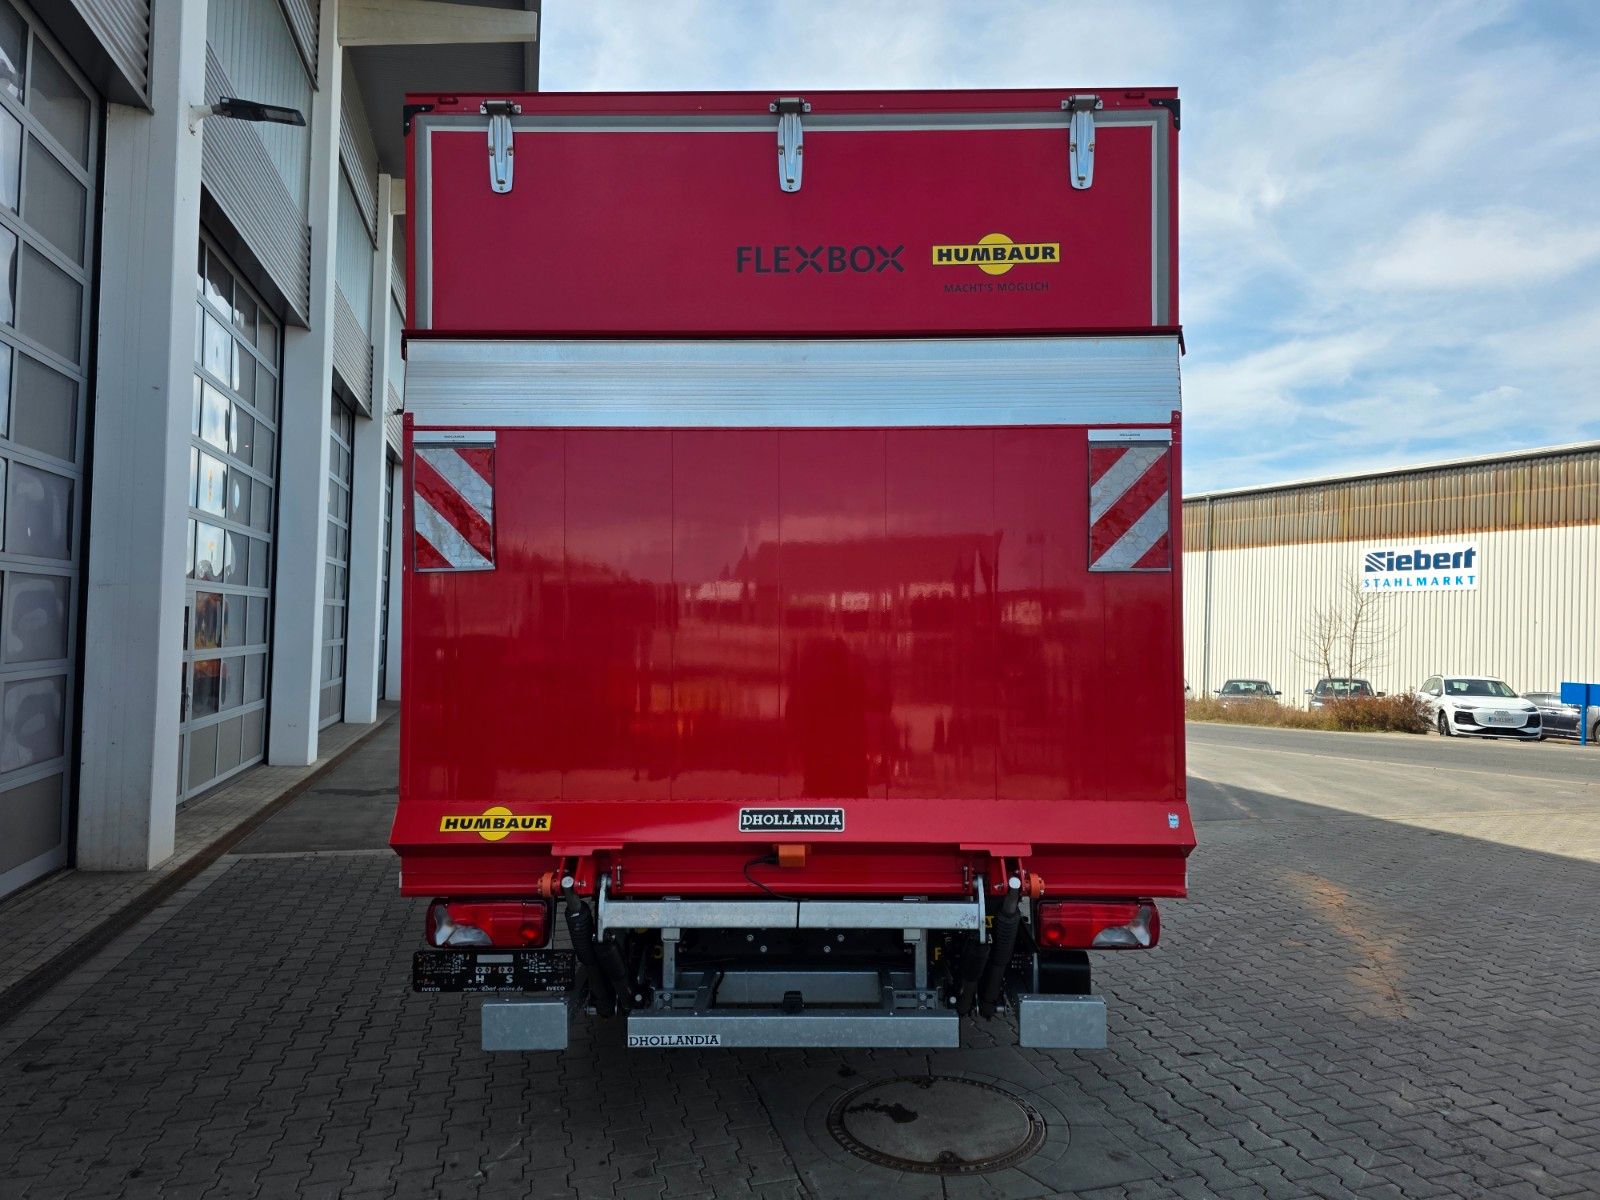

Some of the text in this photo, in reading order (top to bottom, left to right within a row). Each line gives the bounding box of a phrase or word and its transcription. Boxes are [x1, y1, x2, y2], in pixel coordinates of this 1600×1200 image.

[736, 245, 904, 273] FLEXBOX
[937, 246, 1056, 262] HUMBAUR
[1364, 547, 1476, 572] Siebert
[1363, 575, 1476, 588] STAHLMARKT
[445, 817, 548, 829] HUMBAUR
[742, 814, 842, 826] DHOLLANDIA
[629, 1034, 719, 1046] DHOLLANDIA
